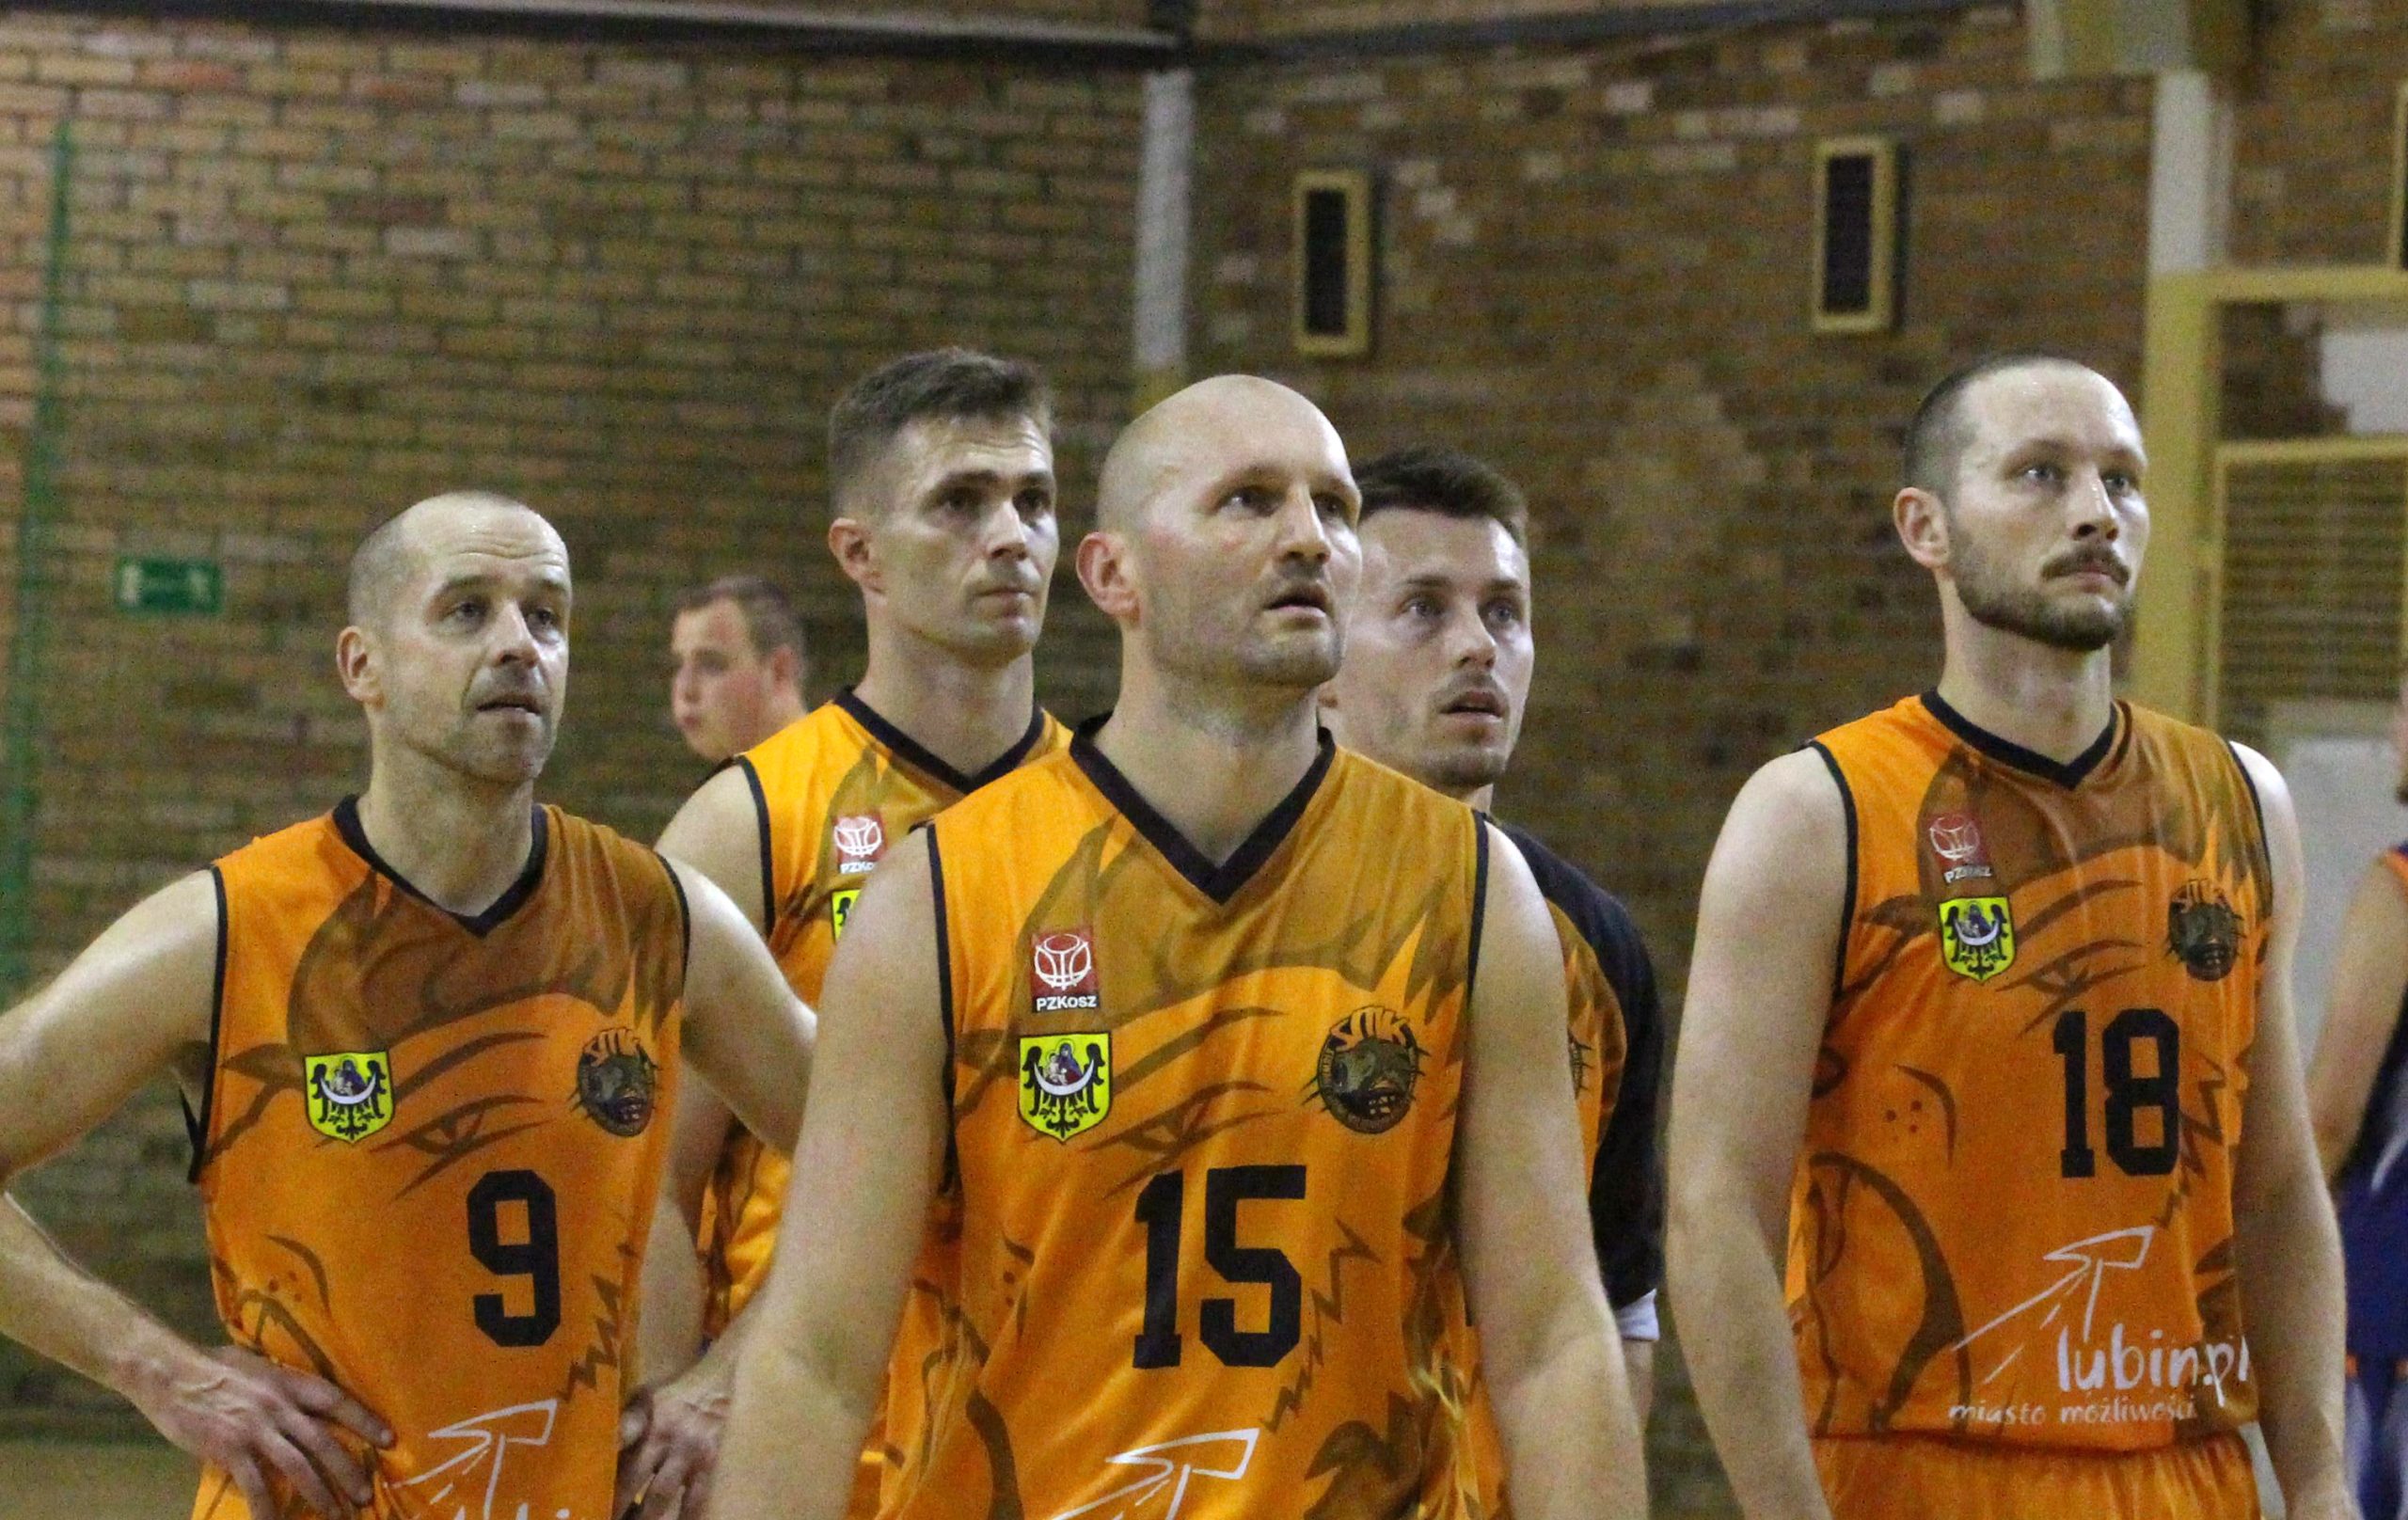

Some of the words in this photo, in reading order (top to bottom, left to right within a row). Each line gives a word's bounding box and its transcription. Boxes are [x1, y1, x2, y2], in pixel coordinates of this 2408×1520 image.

[2052, 1007, 2179, 1179] 18
[466, 1169, 561, 1347] 9
[1132, 1164, 1307, 1370] 15
